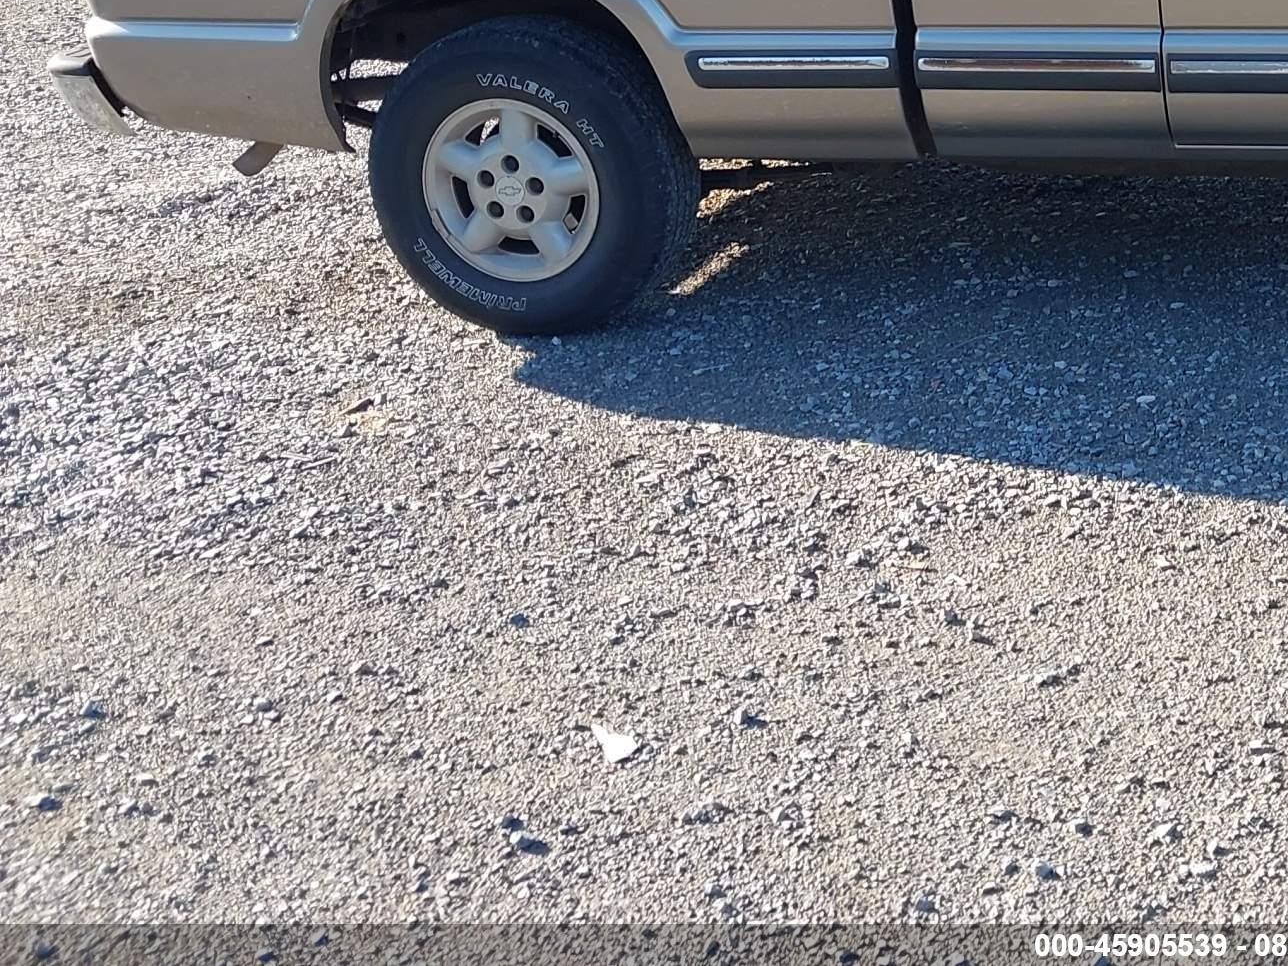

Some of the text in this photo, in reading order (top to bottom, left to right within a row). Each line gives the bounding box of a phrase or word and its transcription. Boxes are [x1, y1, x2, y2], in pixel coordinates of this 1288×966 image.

[476, 73, 605, 148] VALERA HT
[414, 237, 527, 311] PRIMEWELL
